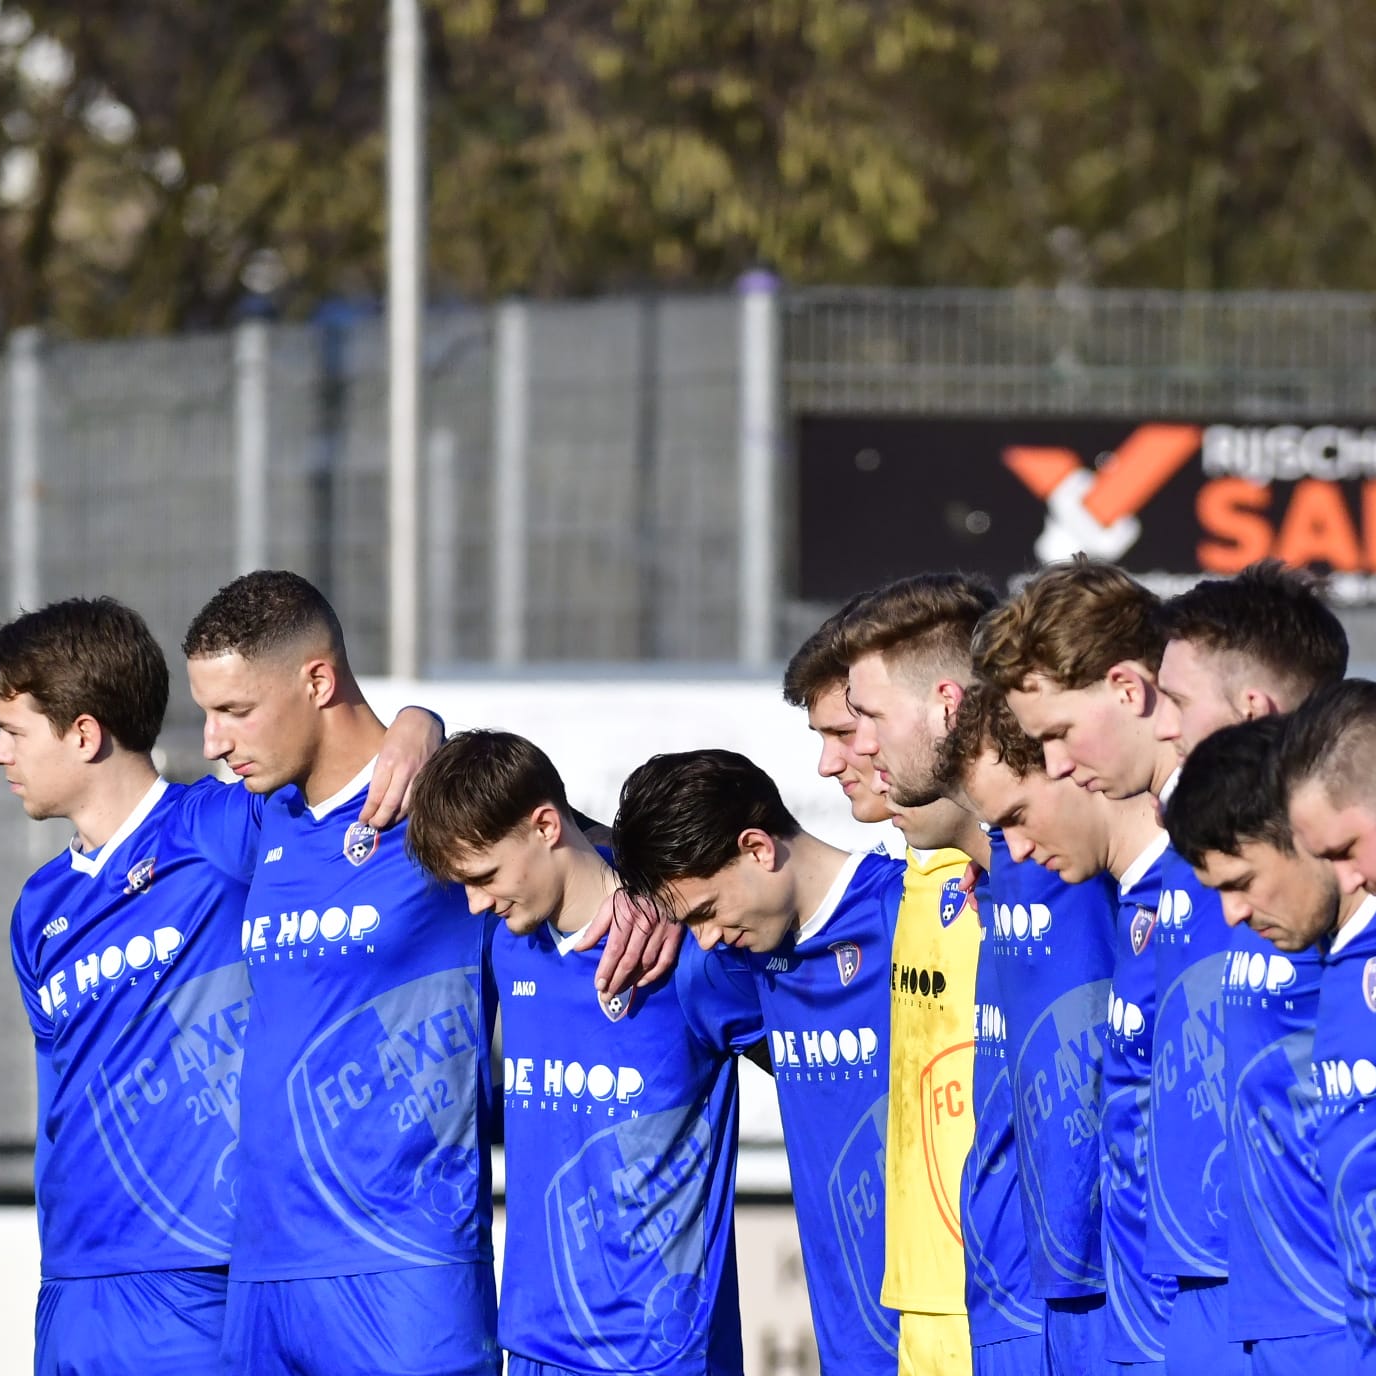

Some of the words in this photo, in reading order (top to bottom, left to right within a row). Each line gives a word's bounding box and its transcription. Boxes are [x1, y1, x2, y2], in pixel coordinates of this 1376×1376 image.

[276, 905, 380, 947] HOOP
[75, 926, 184, 994] HOOP
[248, 944, 375, 966] ERNEUZEN
[512, 981, 536, 996] JAKO
[900, 965, 946, 998] HOOP
[115, 1057, 167, 1124] FC
[169, 998, 249, 1083] AXE
[772, 1030, 800, 1067] DE
[802, 1027, 879, 1068] HOOP
[315, 1061, 372, 1129] FC
[544, 1059, 645, 1104] HOOP
[776, 1069, 878, 1082] TERNEUZEN
[391, 1078, 450, 1133] 2012
[933, 1080, 964, 1125] FC
[1024, 1070, 1053, 1139] FC
[567, 1186, 604, 1251] FC
[847, 1170, 877, 1238] FC
